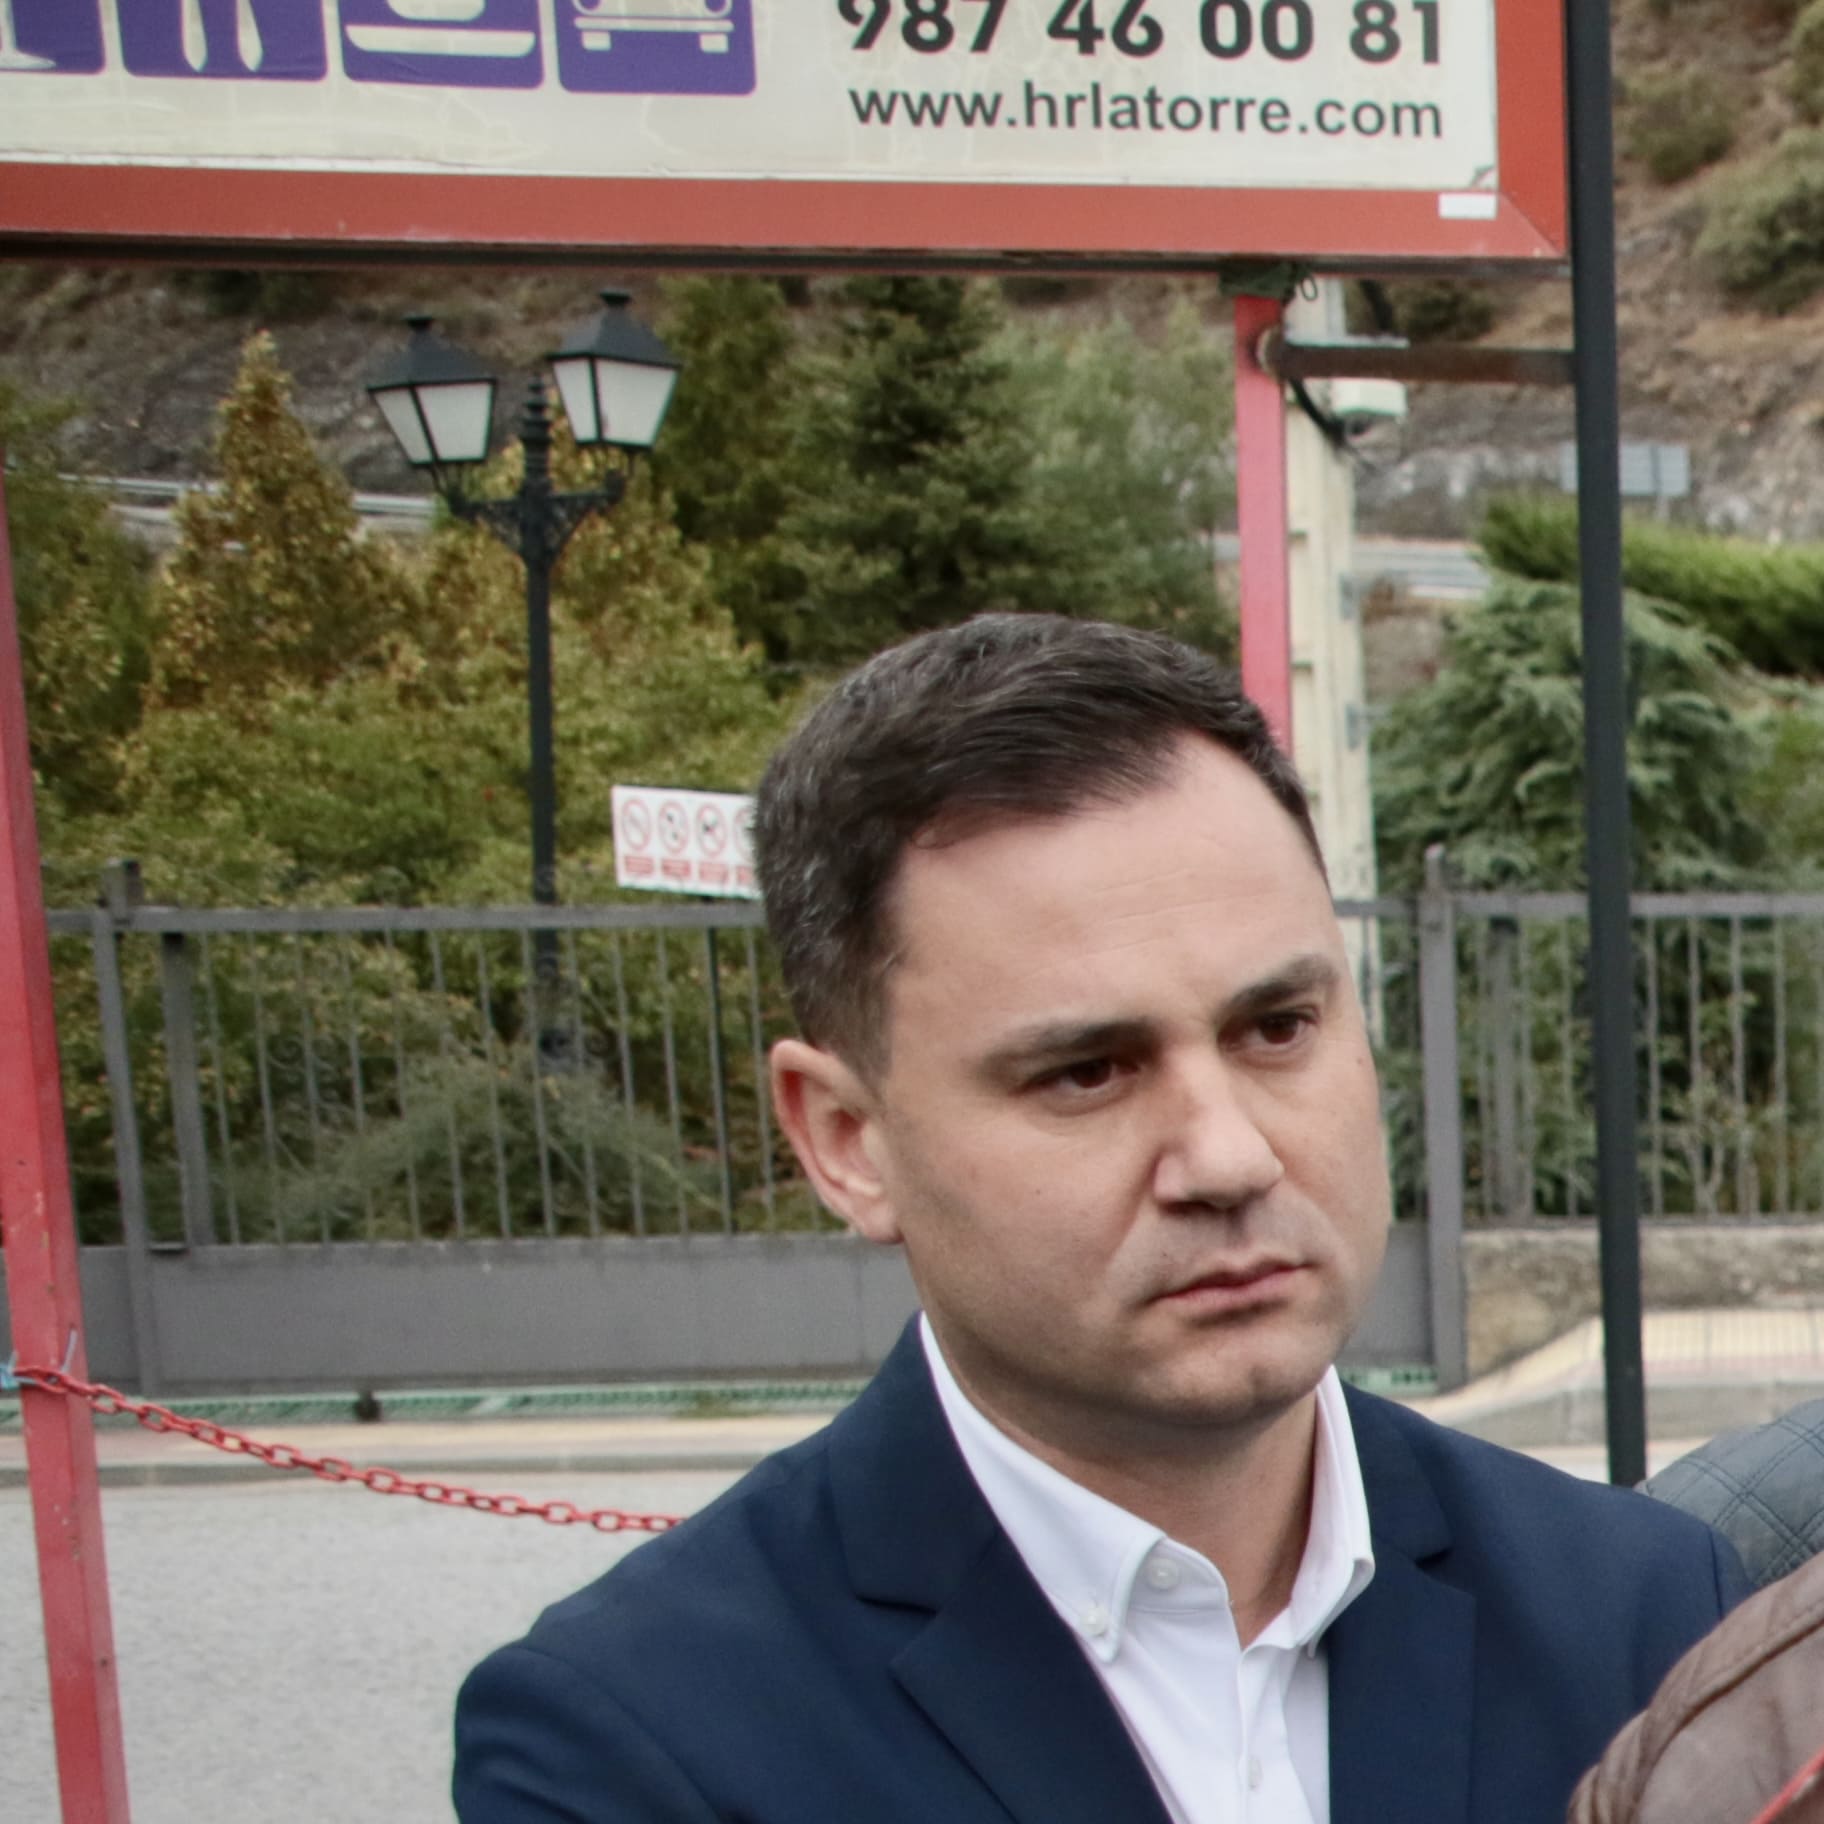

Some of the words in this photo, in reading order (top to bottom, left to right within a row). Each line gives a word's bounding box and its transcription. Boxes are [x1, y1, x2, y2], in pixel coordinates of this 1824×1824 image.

[836, 0, 1002, 54] 987
[1046, 0, 1164, 58] 46
[1199, 0, 1315, 61] 00
[1348, 0, 1442, 64] 81
[847, 80, 1443, 139] www.hrlatorre.com
